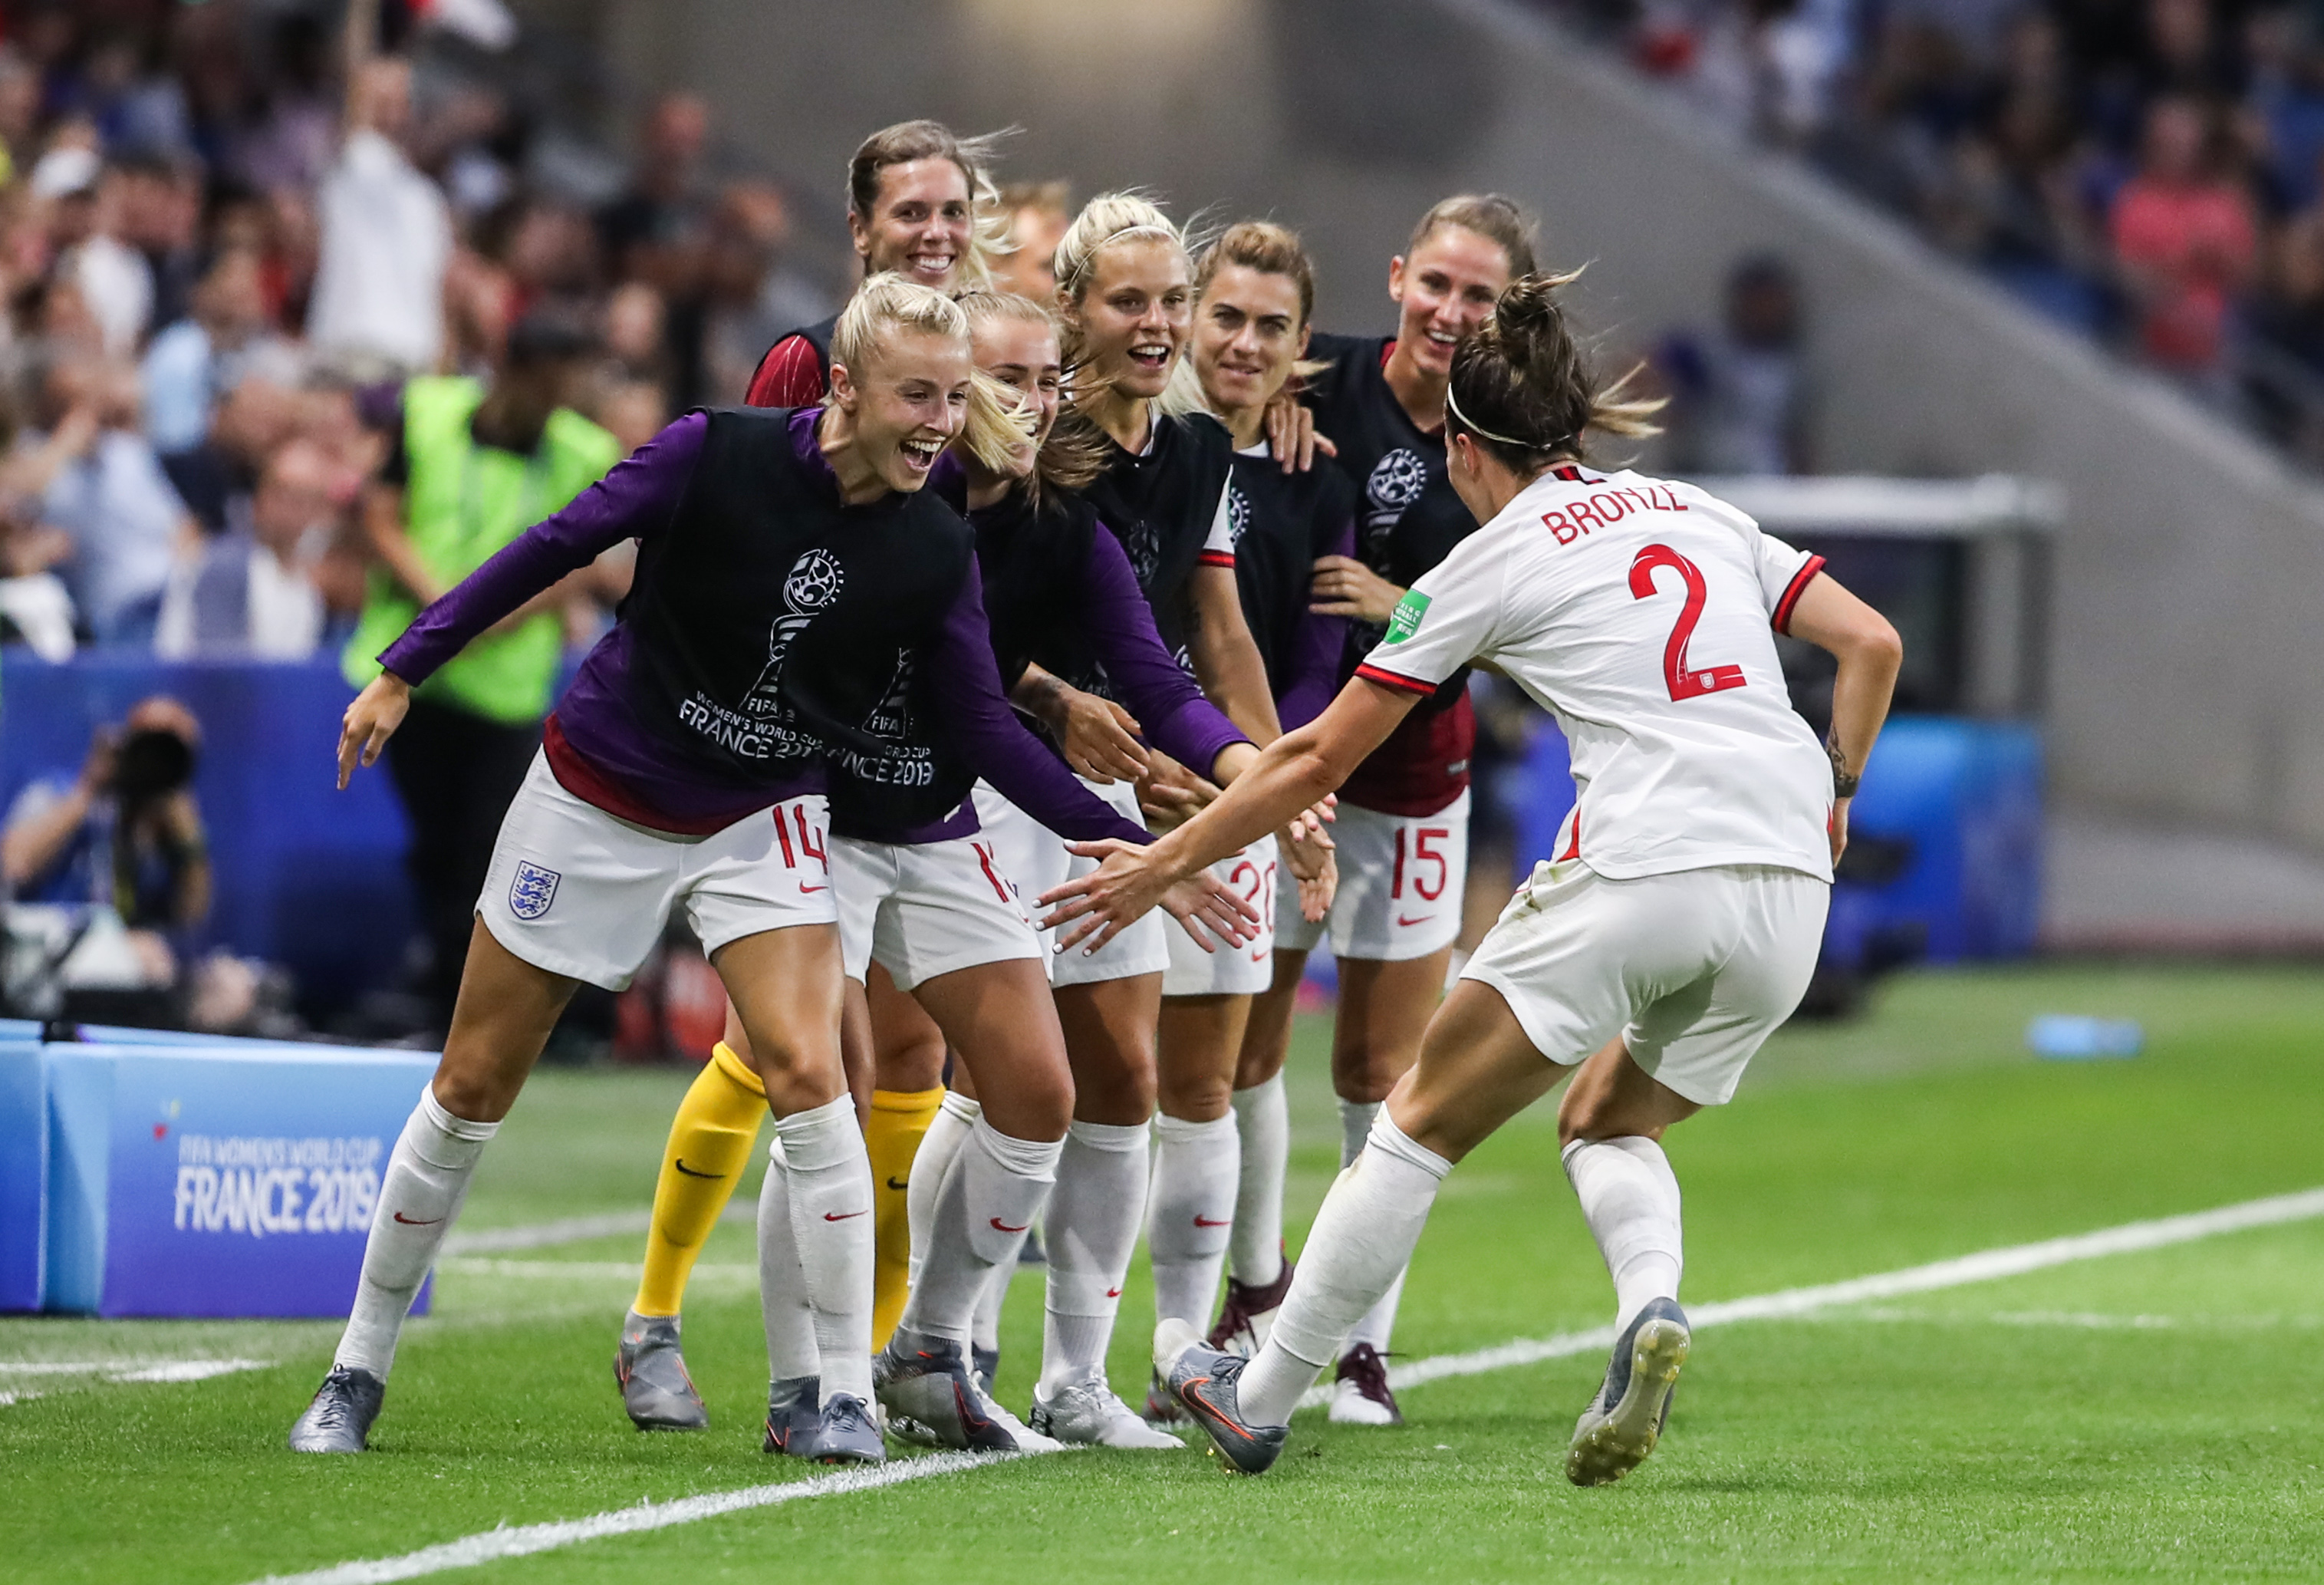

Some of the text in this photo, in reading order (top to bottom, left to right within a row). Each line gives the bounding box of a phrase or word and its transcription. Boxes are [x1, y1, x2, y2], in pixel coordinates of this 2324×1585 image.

[1541, 484, 1689, 545] BRONZE
[1628, 543, 1748, 703] 2
[679, 698, 773, 759] FRANCE
[696, 690, 751, 730] WOMEN'S
[755, 721, 797, 741] WORLD
[747, 697, 779, 714] FIFA
[871, 716, 899, 733] FIFA
[772, 804, 828, 875] 14
[1391, 827, 1449, 901] 15
[174, 1166, 381, 1239] FRANCE 2019
